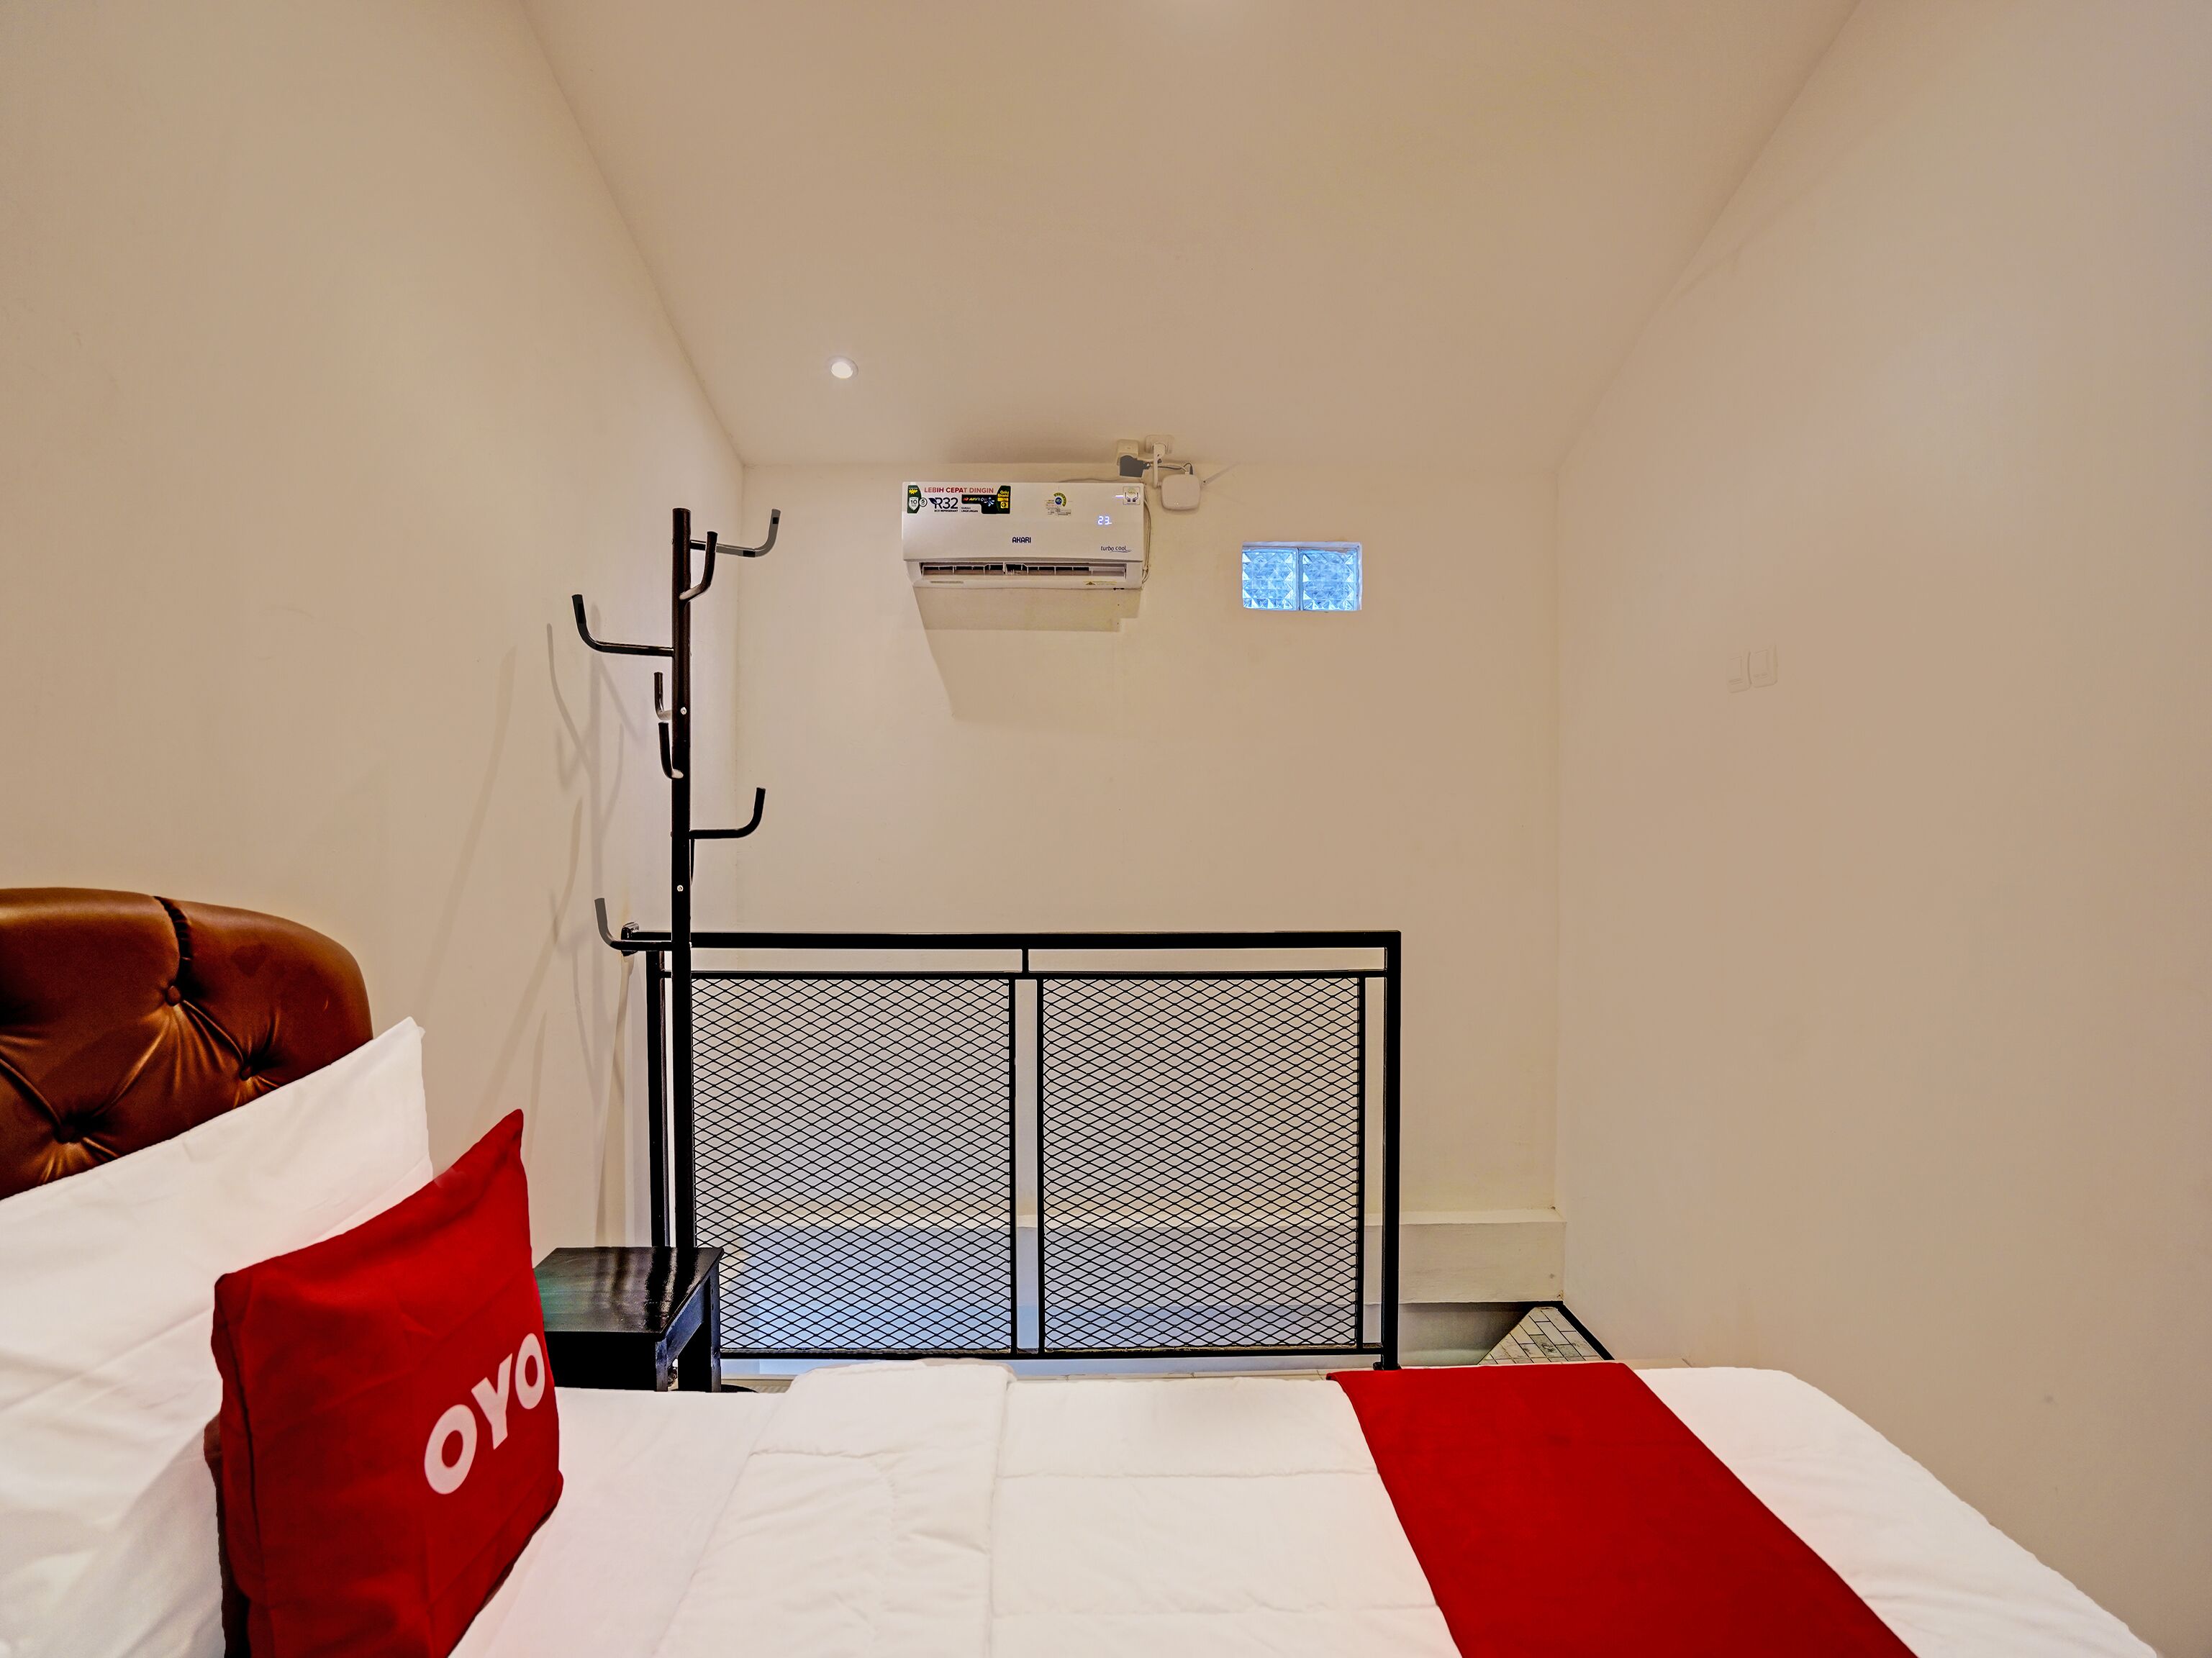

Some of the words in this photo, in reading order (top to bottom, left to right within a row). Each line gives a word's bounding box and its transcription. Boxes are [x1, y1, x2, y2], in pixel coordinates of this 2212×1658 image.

[933, 497, 958, 509] R32
[1097, 515, 1110, 525] 23
[425, 1333, 545, 1495] OYO
